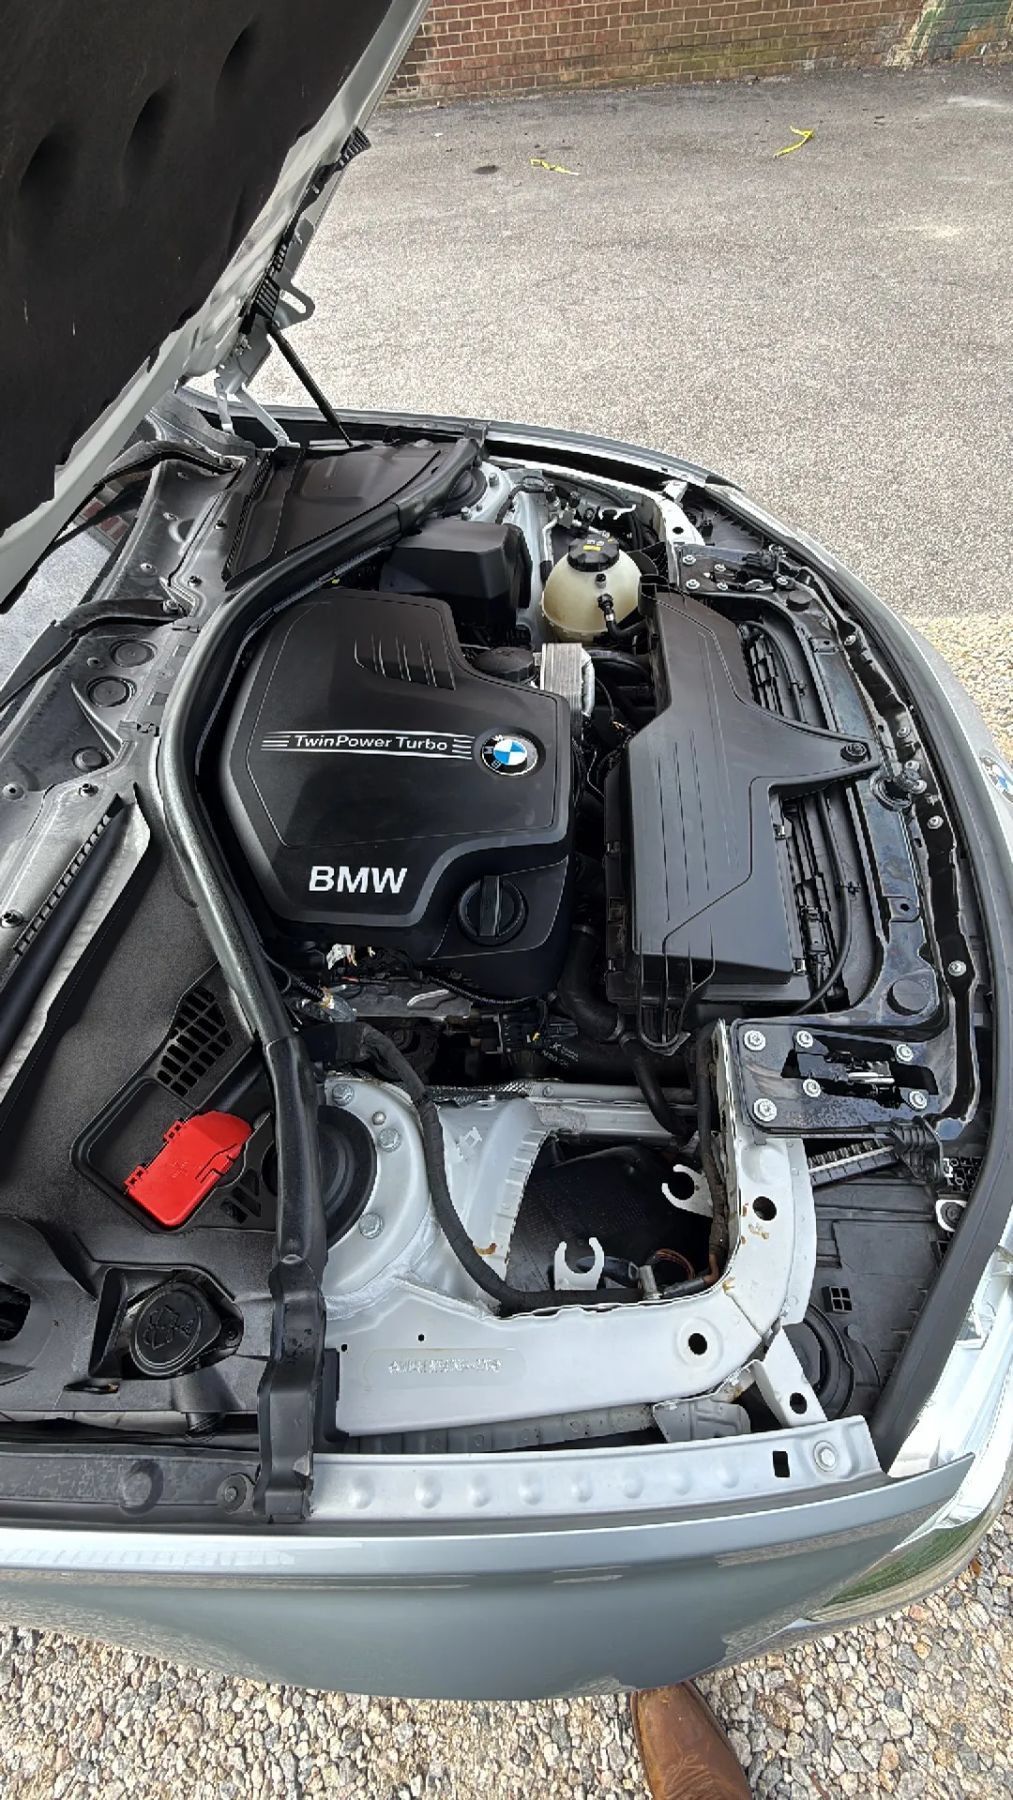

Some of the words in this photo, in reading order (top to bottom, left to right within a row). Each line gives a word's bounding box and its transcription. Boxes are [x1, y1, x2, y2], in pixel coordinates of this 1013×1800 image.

[294, 734, 392, 748] TwinPower
[395, 736, 448, 751] Turbo
[308, 865, 408, 894] BMW
